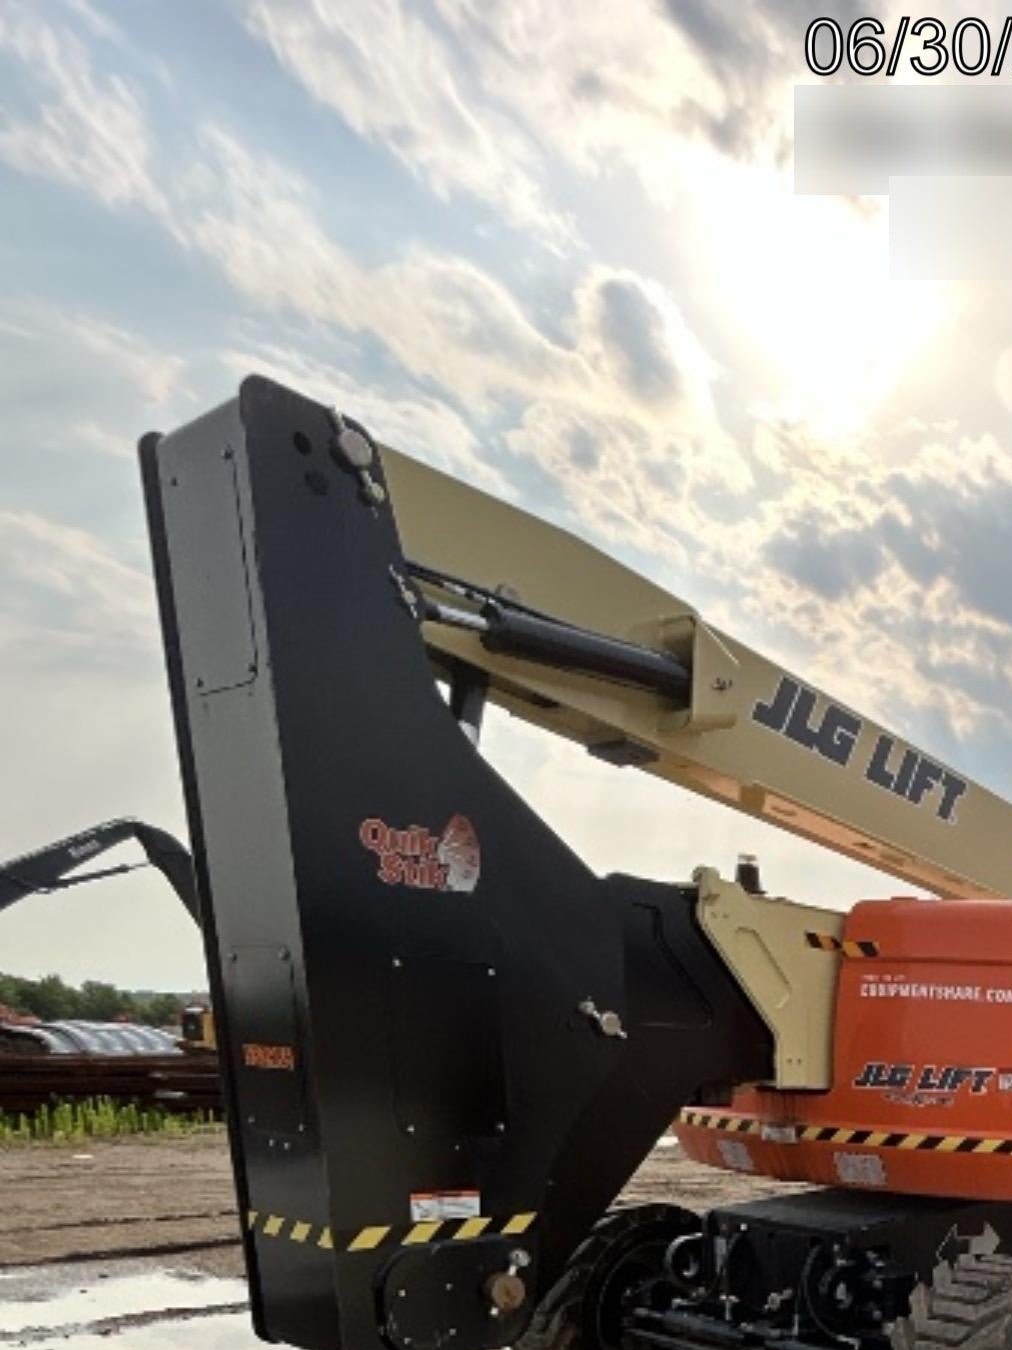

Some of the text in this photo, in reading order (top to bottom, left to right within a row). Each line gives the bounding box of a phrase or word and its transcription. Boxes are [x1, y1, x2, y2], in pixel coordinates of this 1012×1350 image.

[750, 675, 968, 824] JLG LIFT
[359, 818, 440, 861] Quik
[853, 1062, 916, 1089] JLG
[916, 1063, 997, 1095] LIFT
